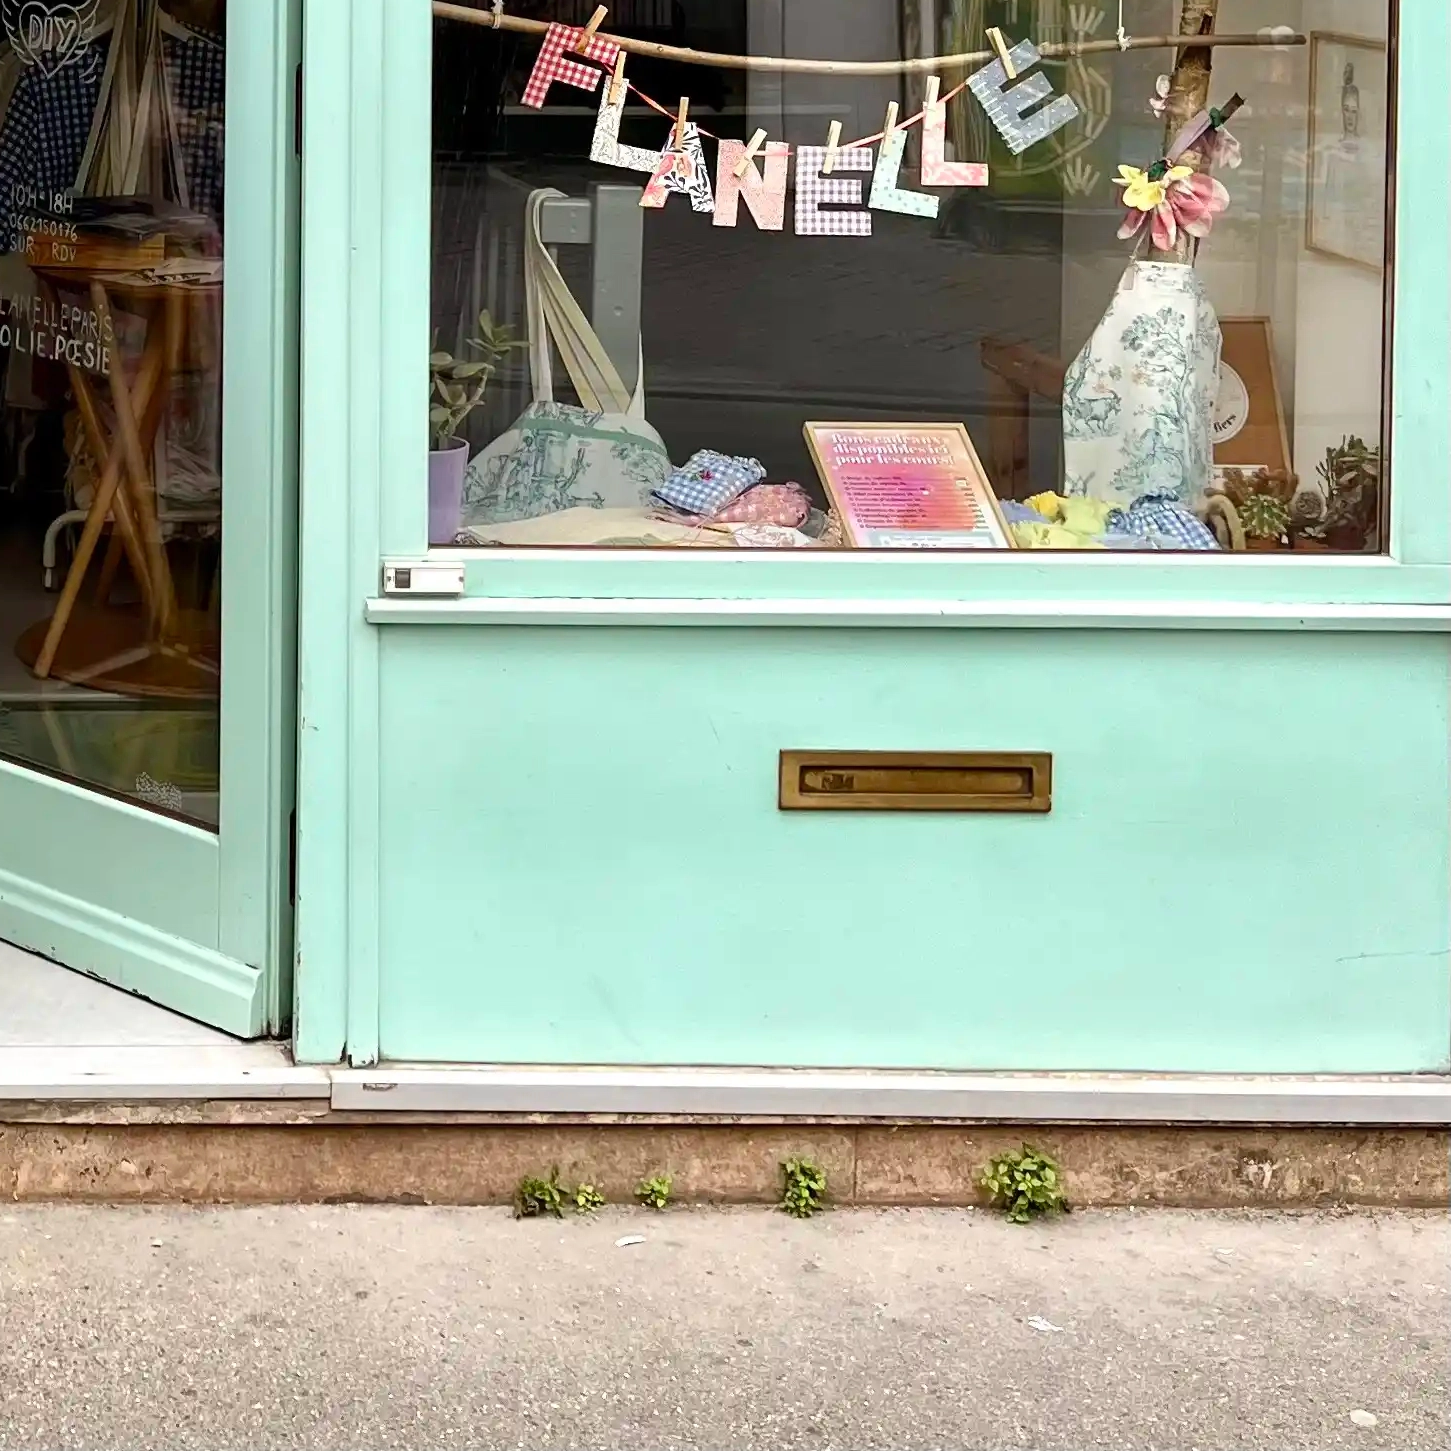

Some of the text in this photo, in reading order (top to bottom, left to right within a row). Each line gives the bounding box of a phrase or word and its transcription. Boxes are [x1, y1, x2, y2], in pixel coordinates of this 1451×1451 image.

[28, 14, 77, 52] DIY
[520, 21, 1079, 237] FLANELLE
[10, 233, 77, 262] SUR RDV
